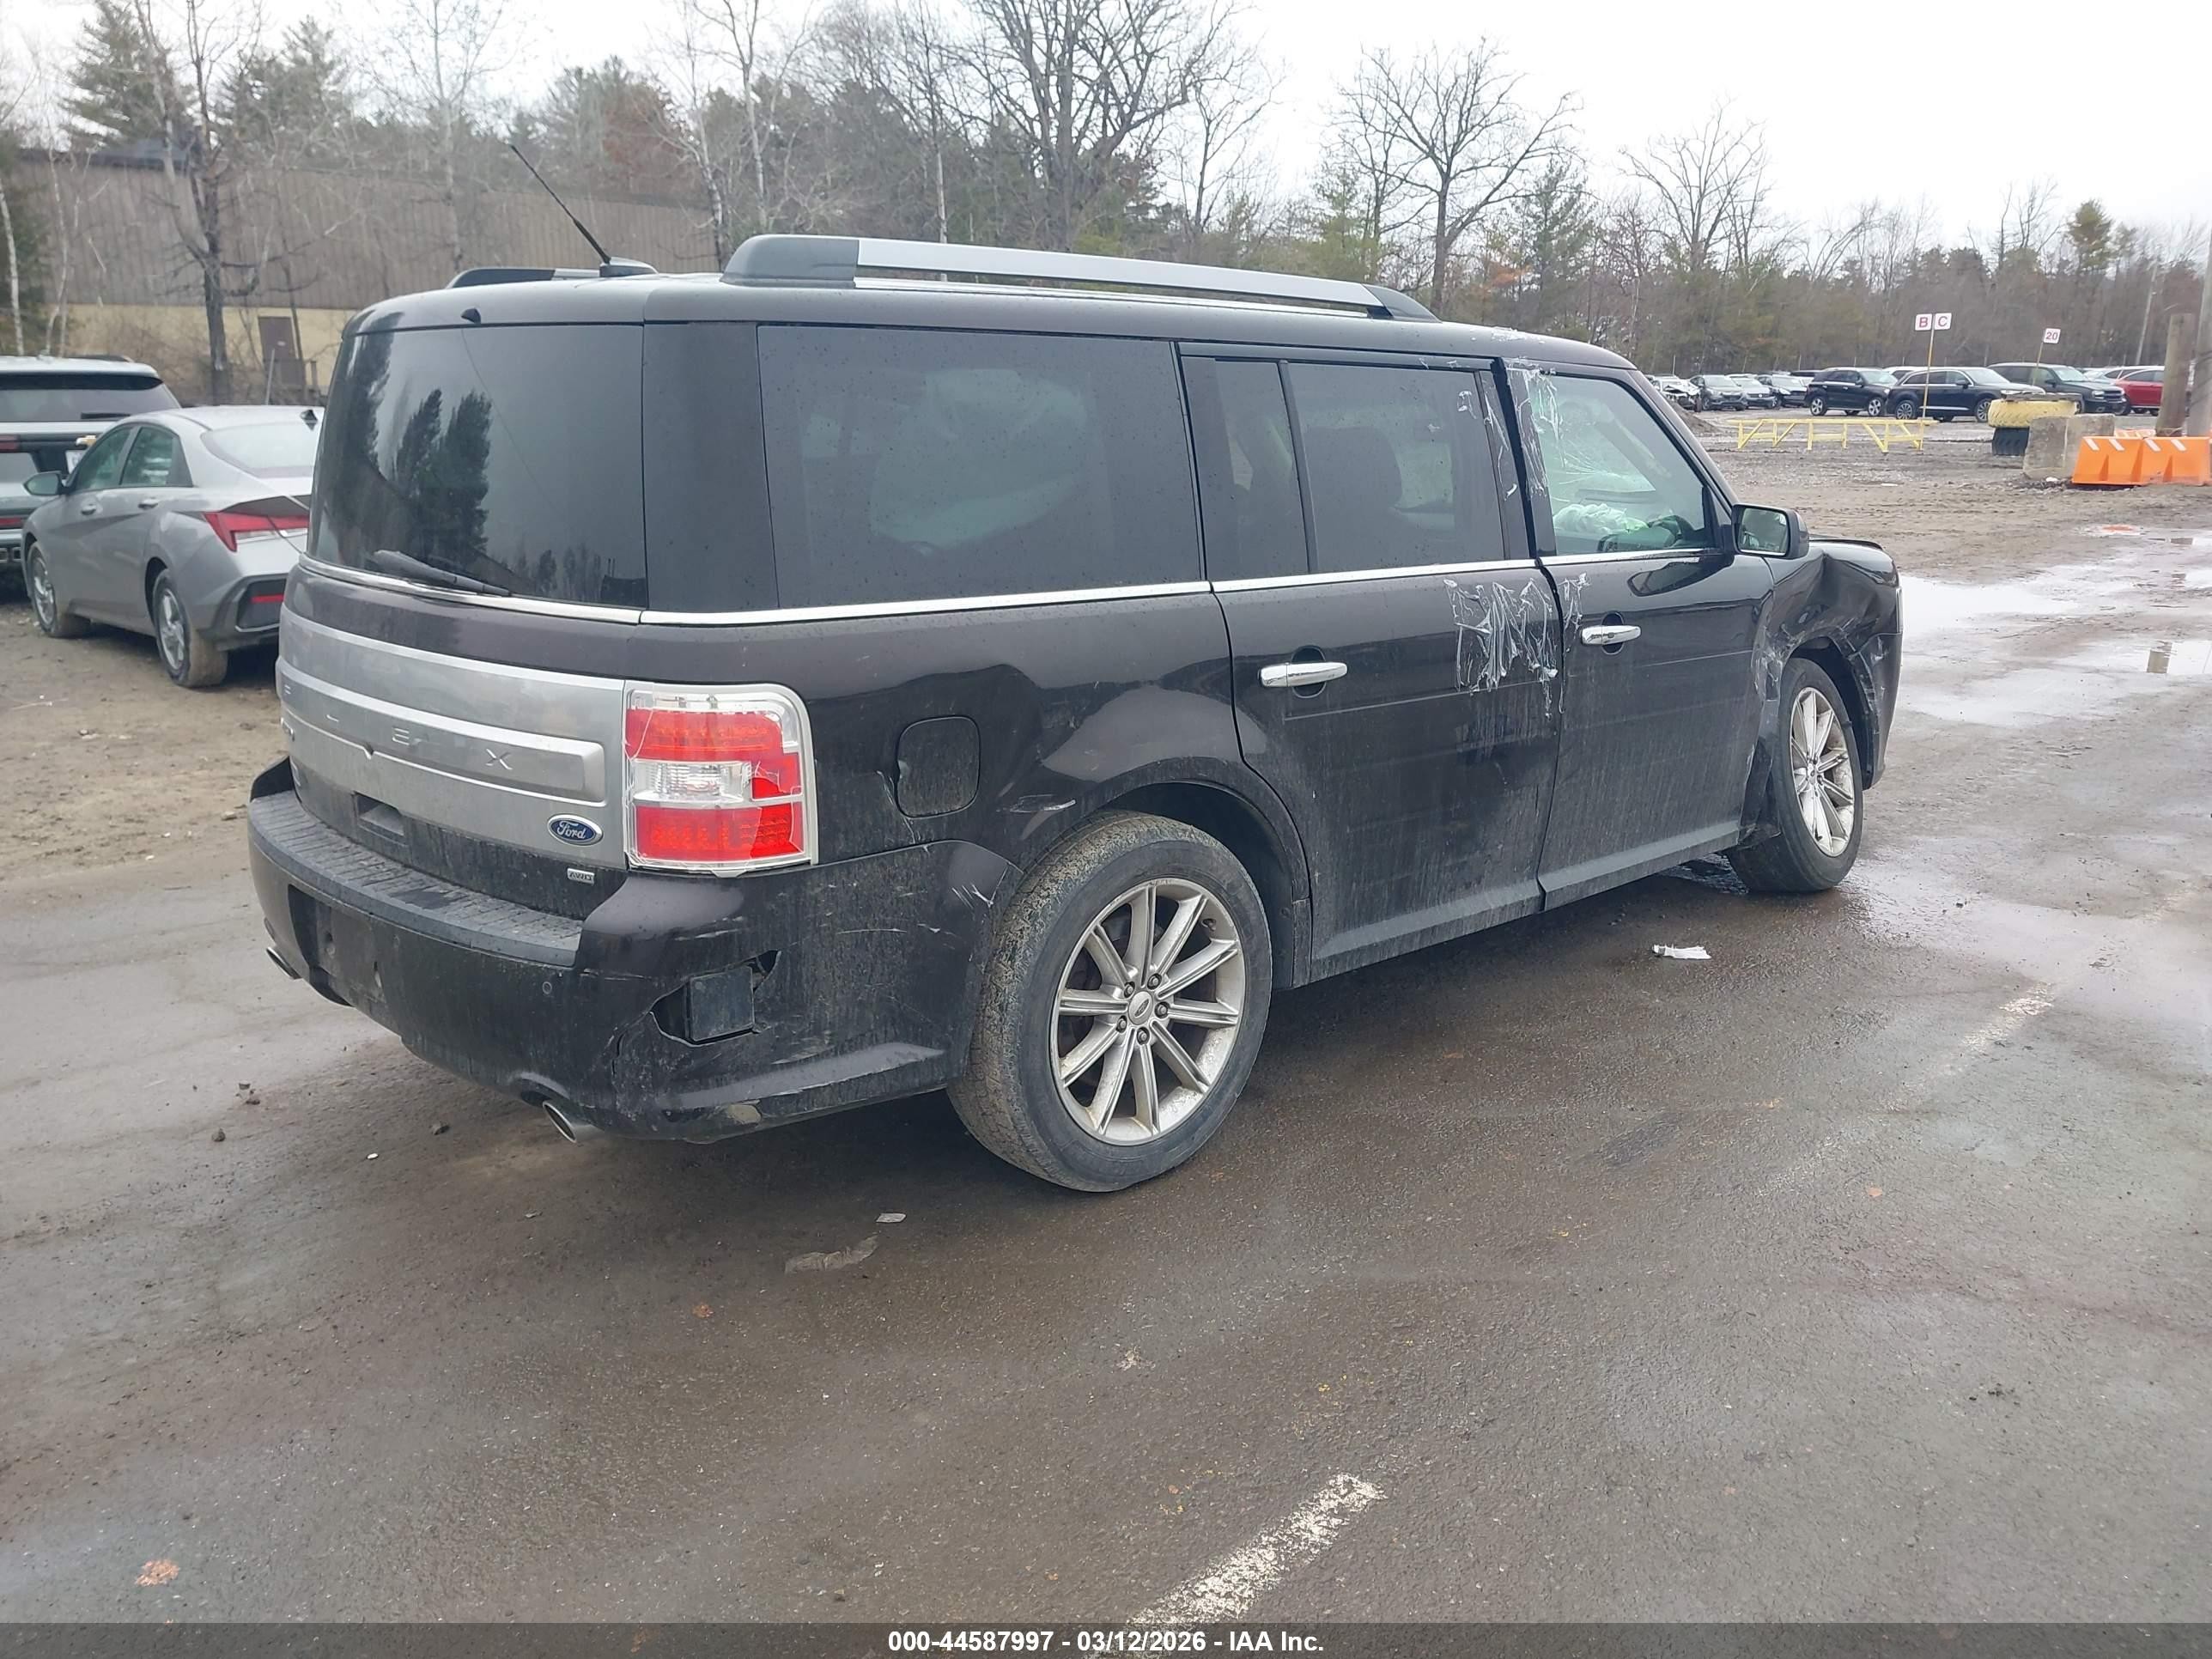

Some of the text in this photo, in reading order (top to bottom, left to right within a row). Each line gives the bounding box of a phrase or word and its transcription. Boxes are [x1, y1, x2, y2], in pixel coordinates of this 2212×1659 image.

[1918, 315, 1948, 328] B C
[2045, 331, 2058, 341] 20
[556, 819, 587, 840] Ford
